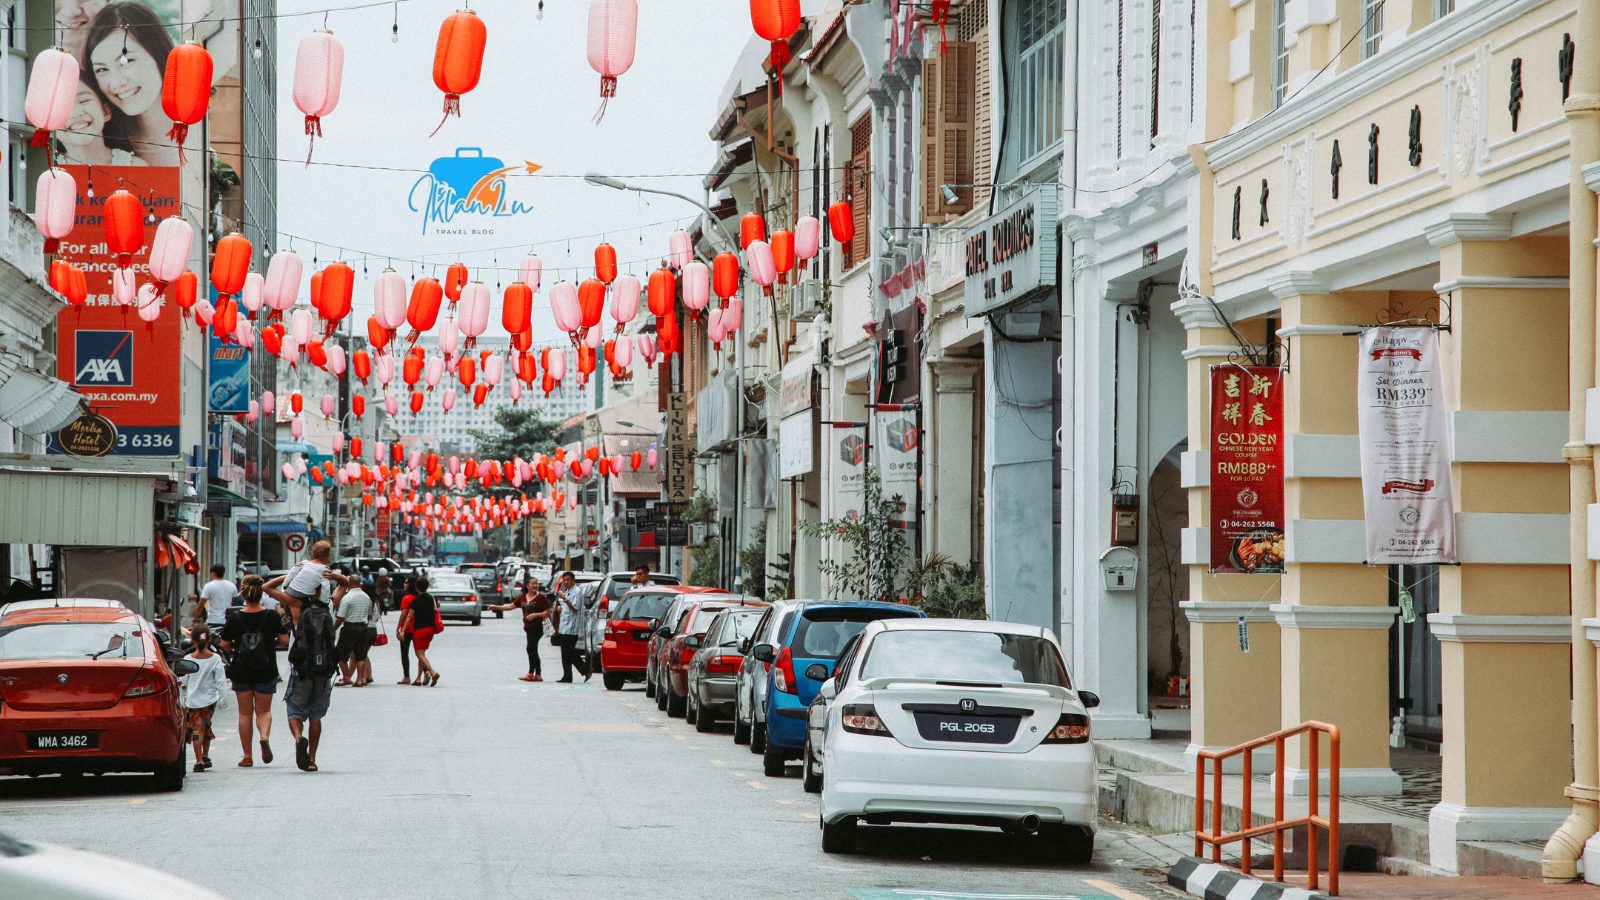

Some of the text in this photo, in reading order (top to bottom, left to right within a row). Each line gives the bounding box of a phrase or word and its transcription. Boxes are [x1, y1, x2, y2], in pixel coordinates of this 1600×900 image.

[60, 241, 86, 254] For
[89, 242, 108, 255] all
[966, 231, 988, 277] PATEL
[1382, 335, 1407, 346] Happy
[76, 358, 125, 382] AXA
[1389, 360, 1403, 368] Day
[1376, 376, 1423, 387] Set Dinner
[73, 433, 100, 446] Hotel
[132, 434, 173, 447] 6336
[1218, 432, 1278, 446] GOLDEN
[672, 395, 685, 498] KLINIK SENTOSA
[1218, 462, 1277, 474] RM888++
[940, 721, 995, 734] PGL 2063
[38, 735, 88, 748] WMA 3462
